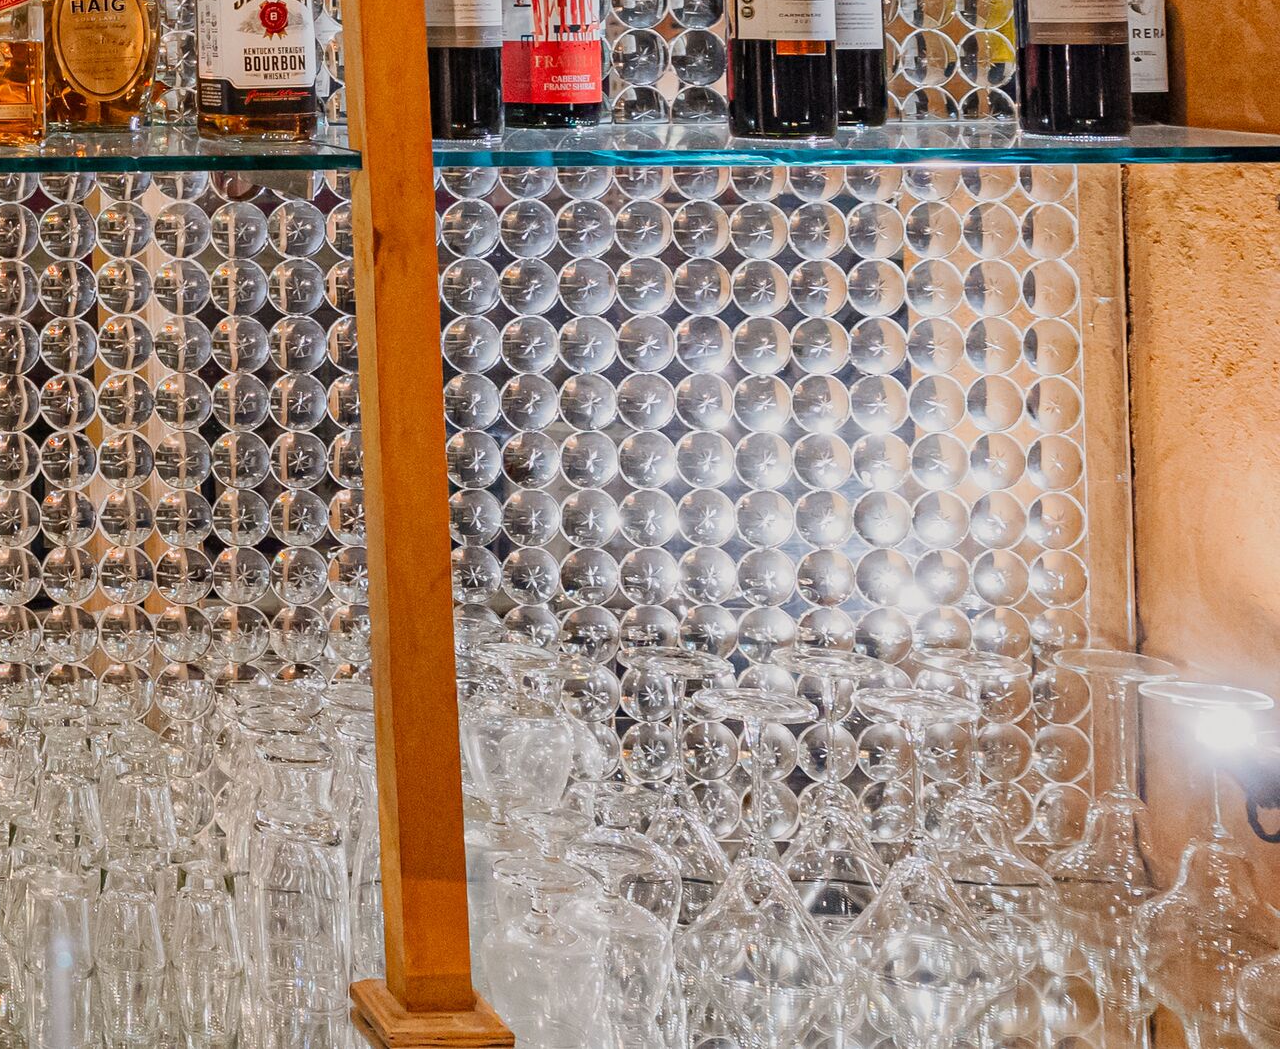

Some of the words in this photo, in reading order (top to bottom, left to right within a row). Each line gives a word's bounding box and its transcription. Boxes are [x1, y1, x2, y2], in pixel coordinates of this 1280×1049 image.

[243, 47, 275, 55] KENTUCKY
[278, 46, 305, 54] STRAIGHT
[244, 54, 306, 72] BOURBON
[263, 72, 290, 80] WHISKEY
[551, 74, 590, 83] CABERNET
[544, 83, 571, 91] FRANC
